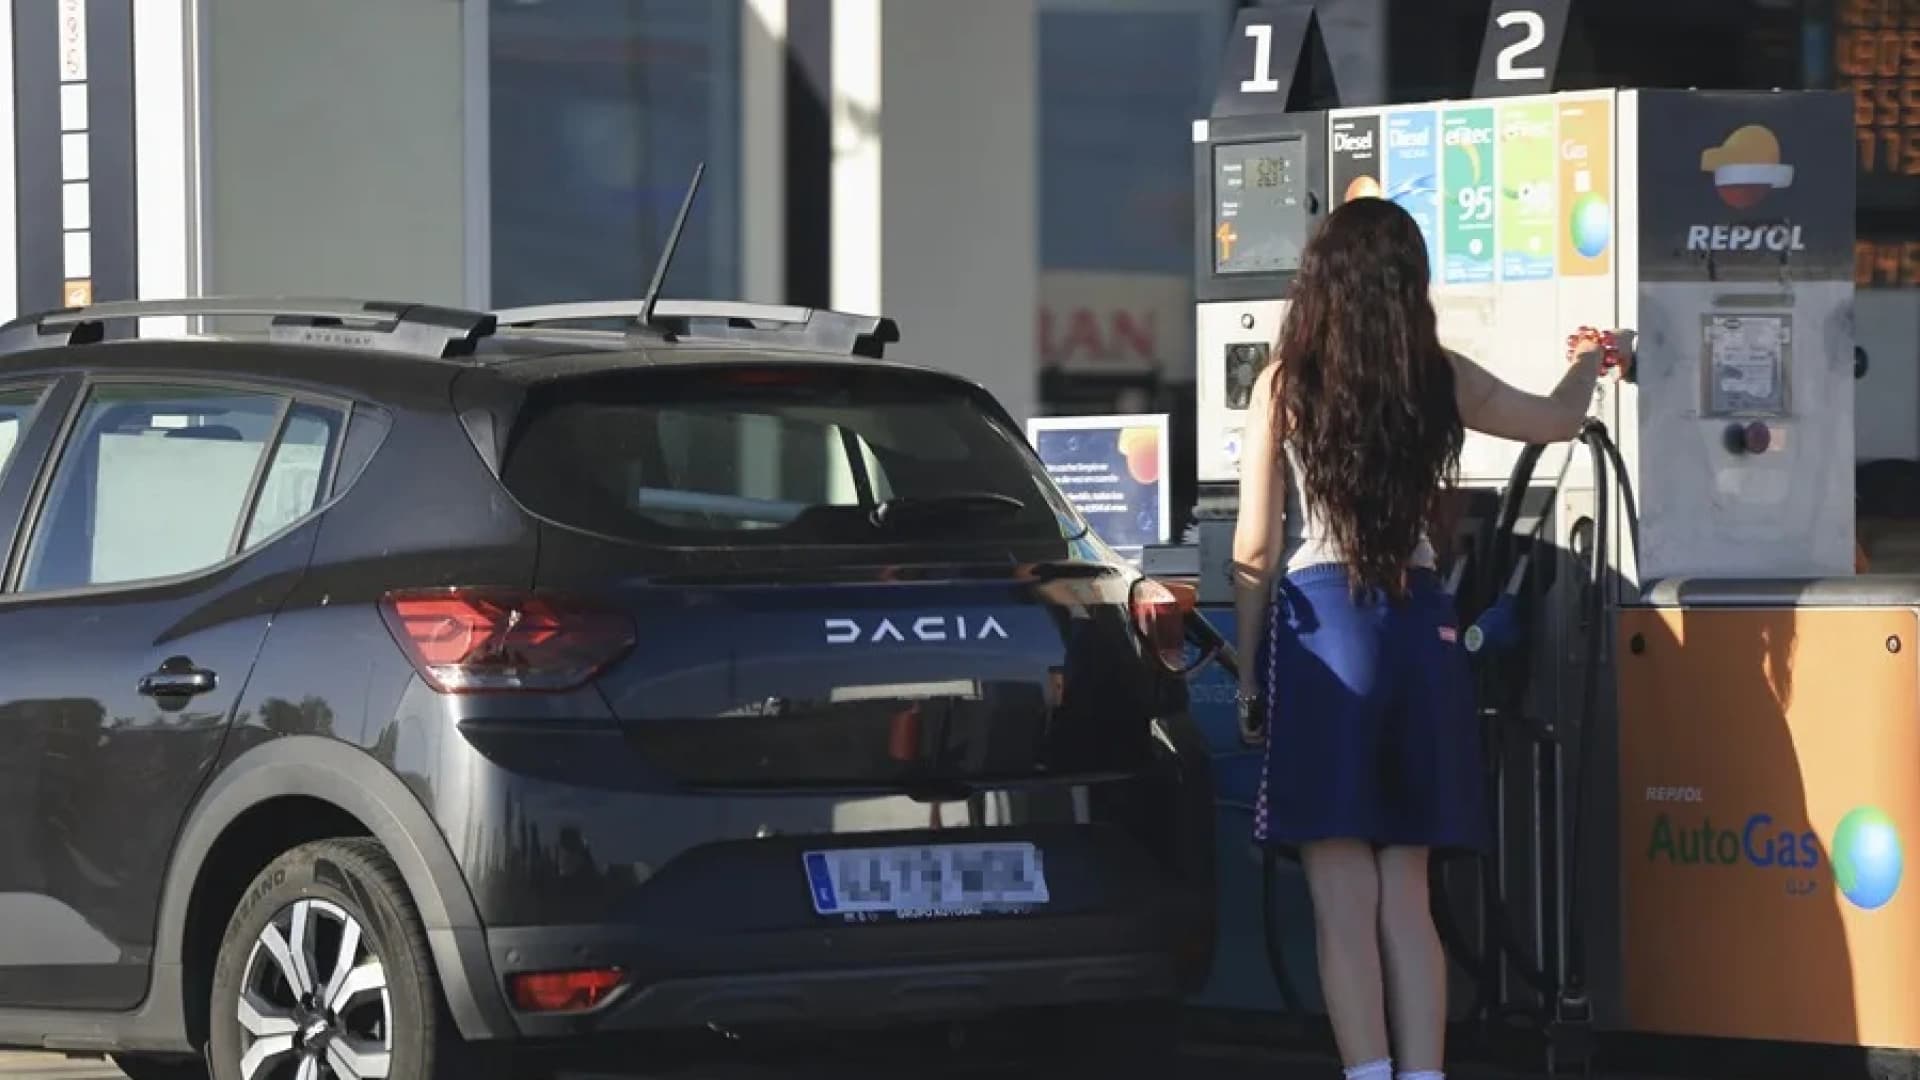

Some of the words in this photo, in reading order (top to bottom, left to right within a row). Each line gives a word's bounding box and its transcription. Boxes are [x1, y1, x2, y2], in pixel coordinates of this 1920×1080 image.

[1240, 24, 1279, 93] 1
[1496, 10, 1546, 81] 2
[1334, 129, 1373, 152] Diesel
[1458, 184, 1493, 221] 95
[1687, 224, 1806, 252] REPSOL
[824, 616, 1009, 644] DACIA
[1649, 813, 1819, 869] AutoGas
